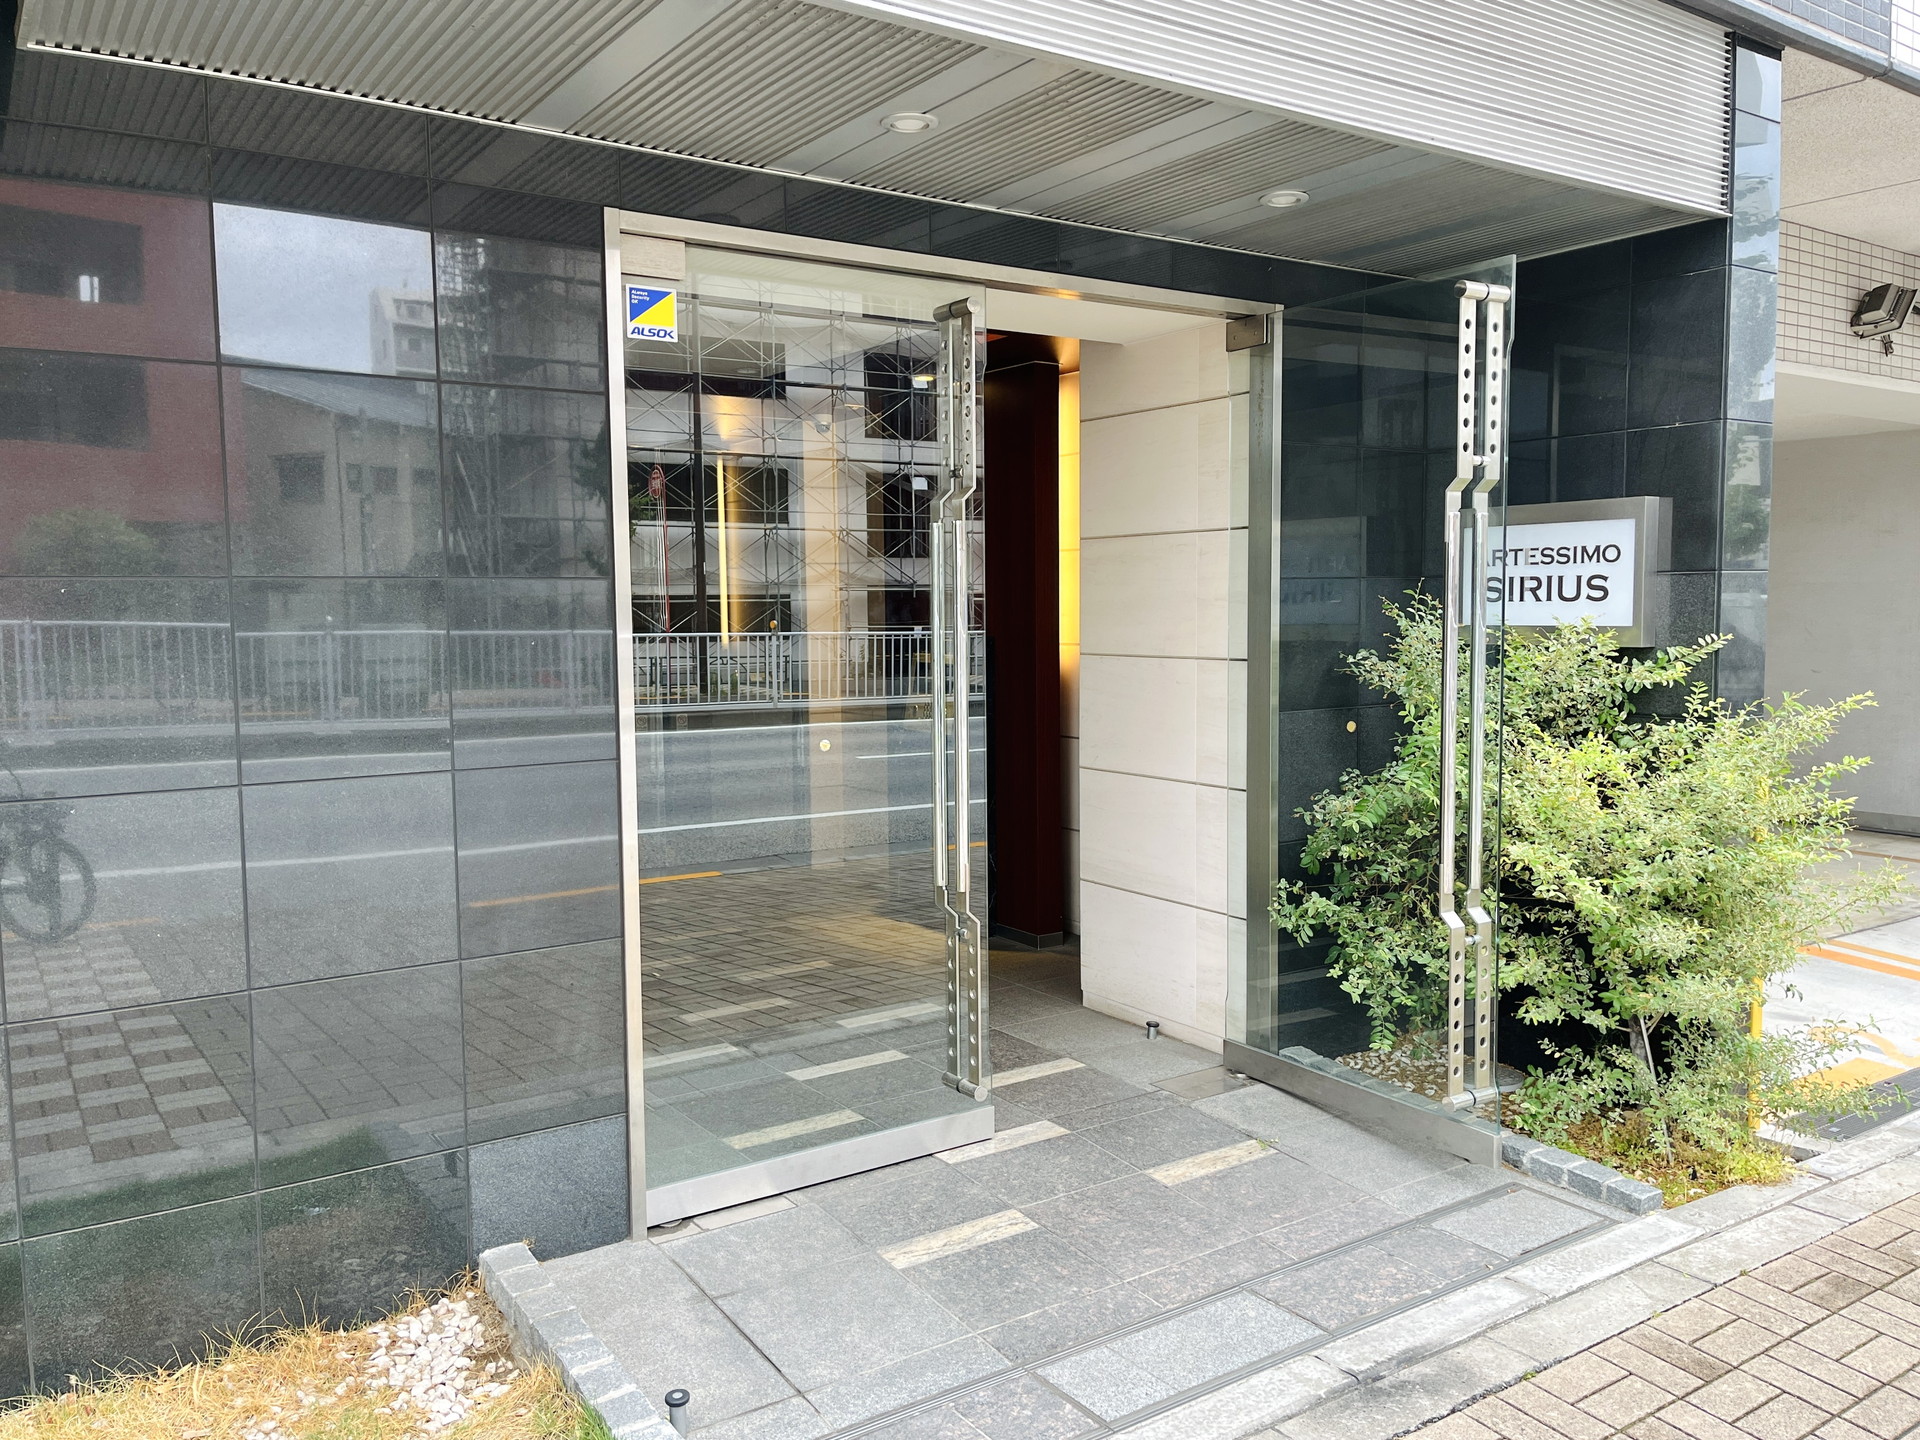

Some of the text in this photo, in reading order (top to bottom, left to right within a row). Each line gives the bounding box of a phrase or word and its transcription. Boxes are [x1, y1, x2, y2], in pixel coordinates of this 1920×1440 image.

[630, 326, 675, 340] ALSOK
[1486, 543, 1622, 567] RTESSIMO
[1486, 573, 1611, 603] SIRIUS
